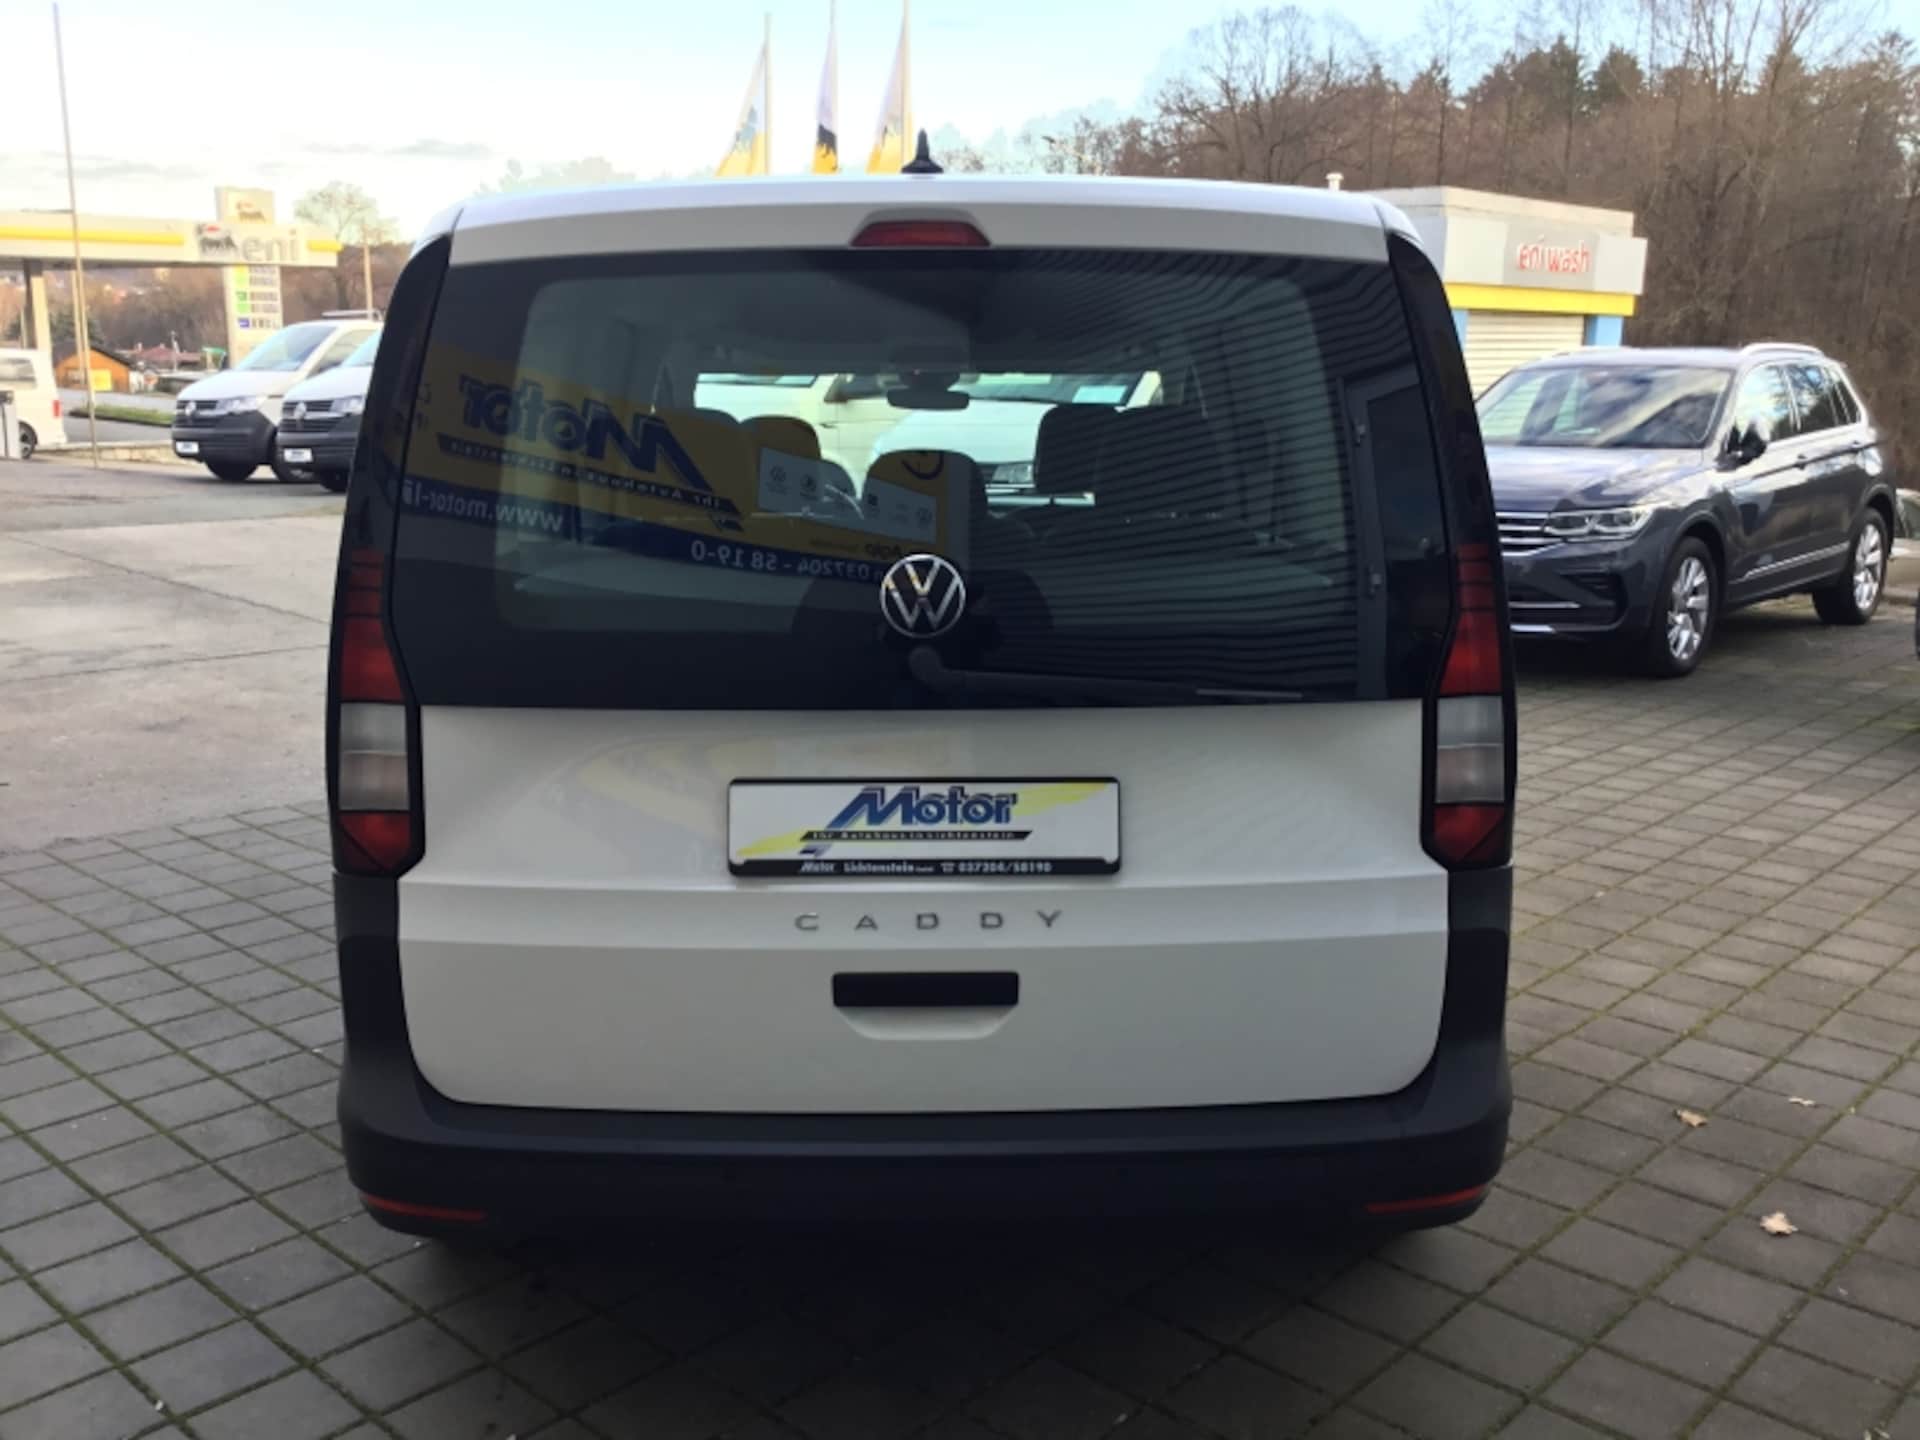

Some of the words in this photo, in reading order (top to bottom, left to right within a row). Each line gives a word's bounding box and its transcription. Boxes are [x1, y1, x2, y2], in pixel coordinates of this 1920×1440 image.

[243, 227, 298, 262] eni
[1548, 241, 1592, 273] wash
[826, 785, 1018, 829] Motor
[795, 910, 1064, 931] CADDY
